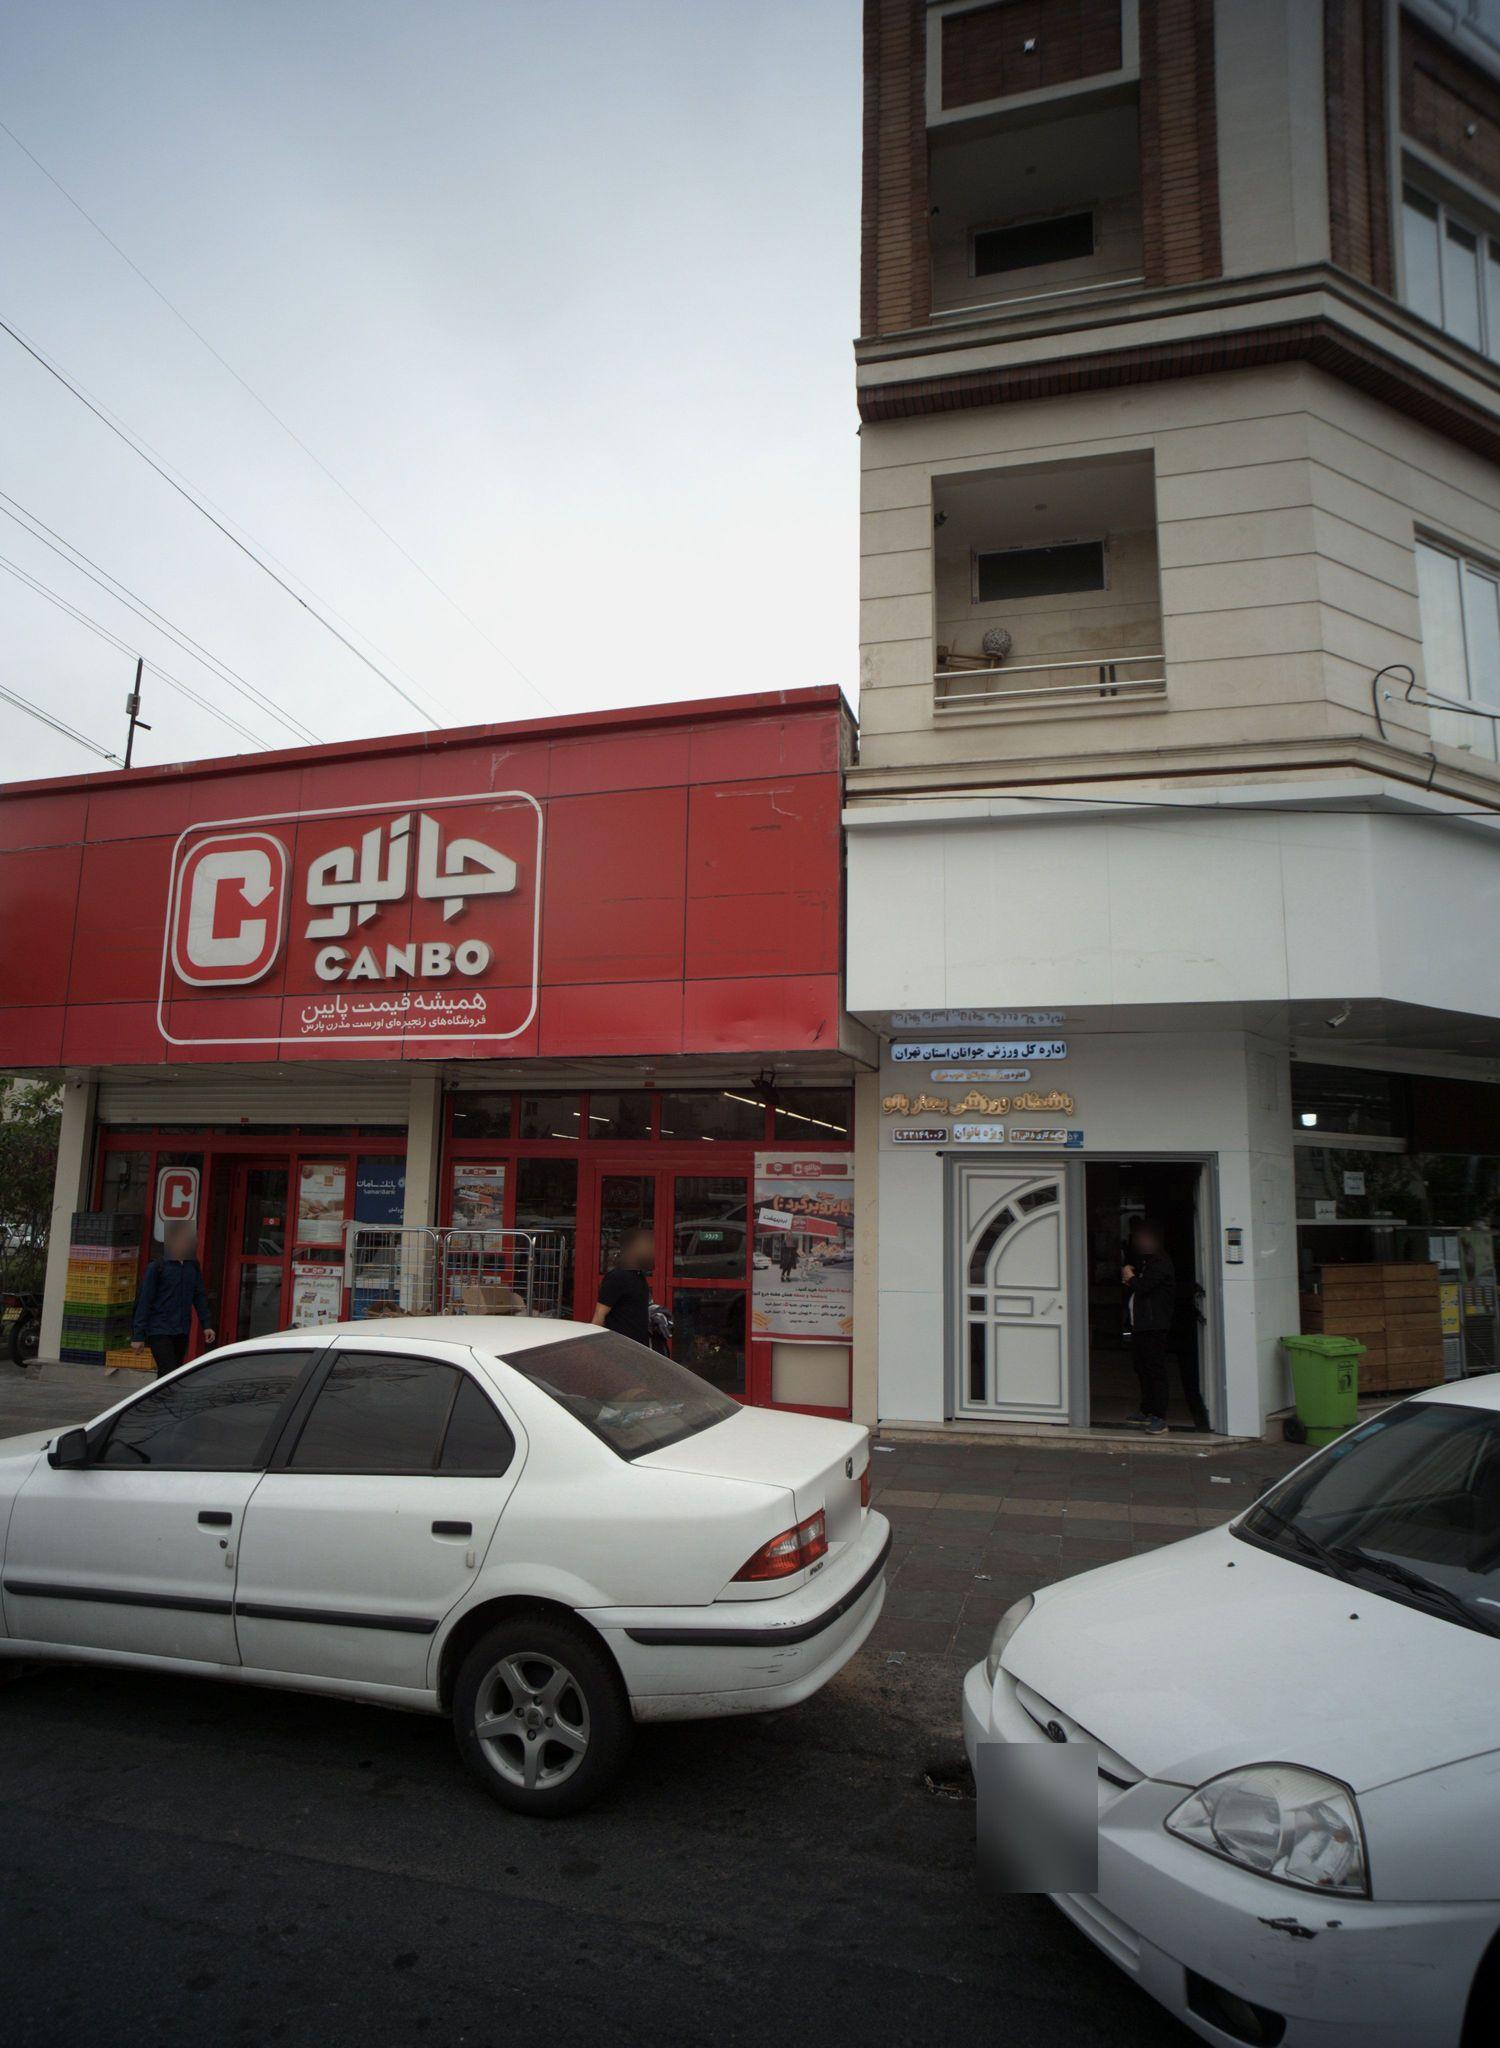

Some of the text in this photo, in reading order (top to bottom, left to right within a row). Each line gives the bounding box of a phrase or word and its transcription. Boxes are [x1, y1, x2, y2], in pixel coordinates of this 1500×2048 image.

[304, 812, 517, 939] جانبو
[314, 939, 493, 981] CANBO
[301, 992, 487, 1023] همیشه قیمت پایین
[895, 1043, 1065, 1060] اداره کل ورزش جوانان استان تهران
[950, 1089, 1010, 1115] ورزشی
[1013, 1089, 1074, 1116] باشگاه
